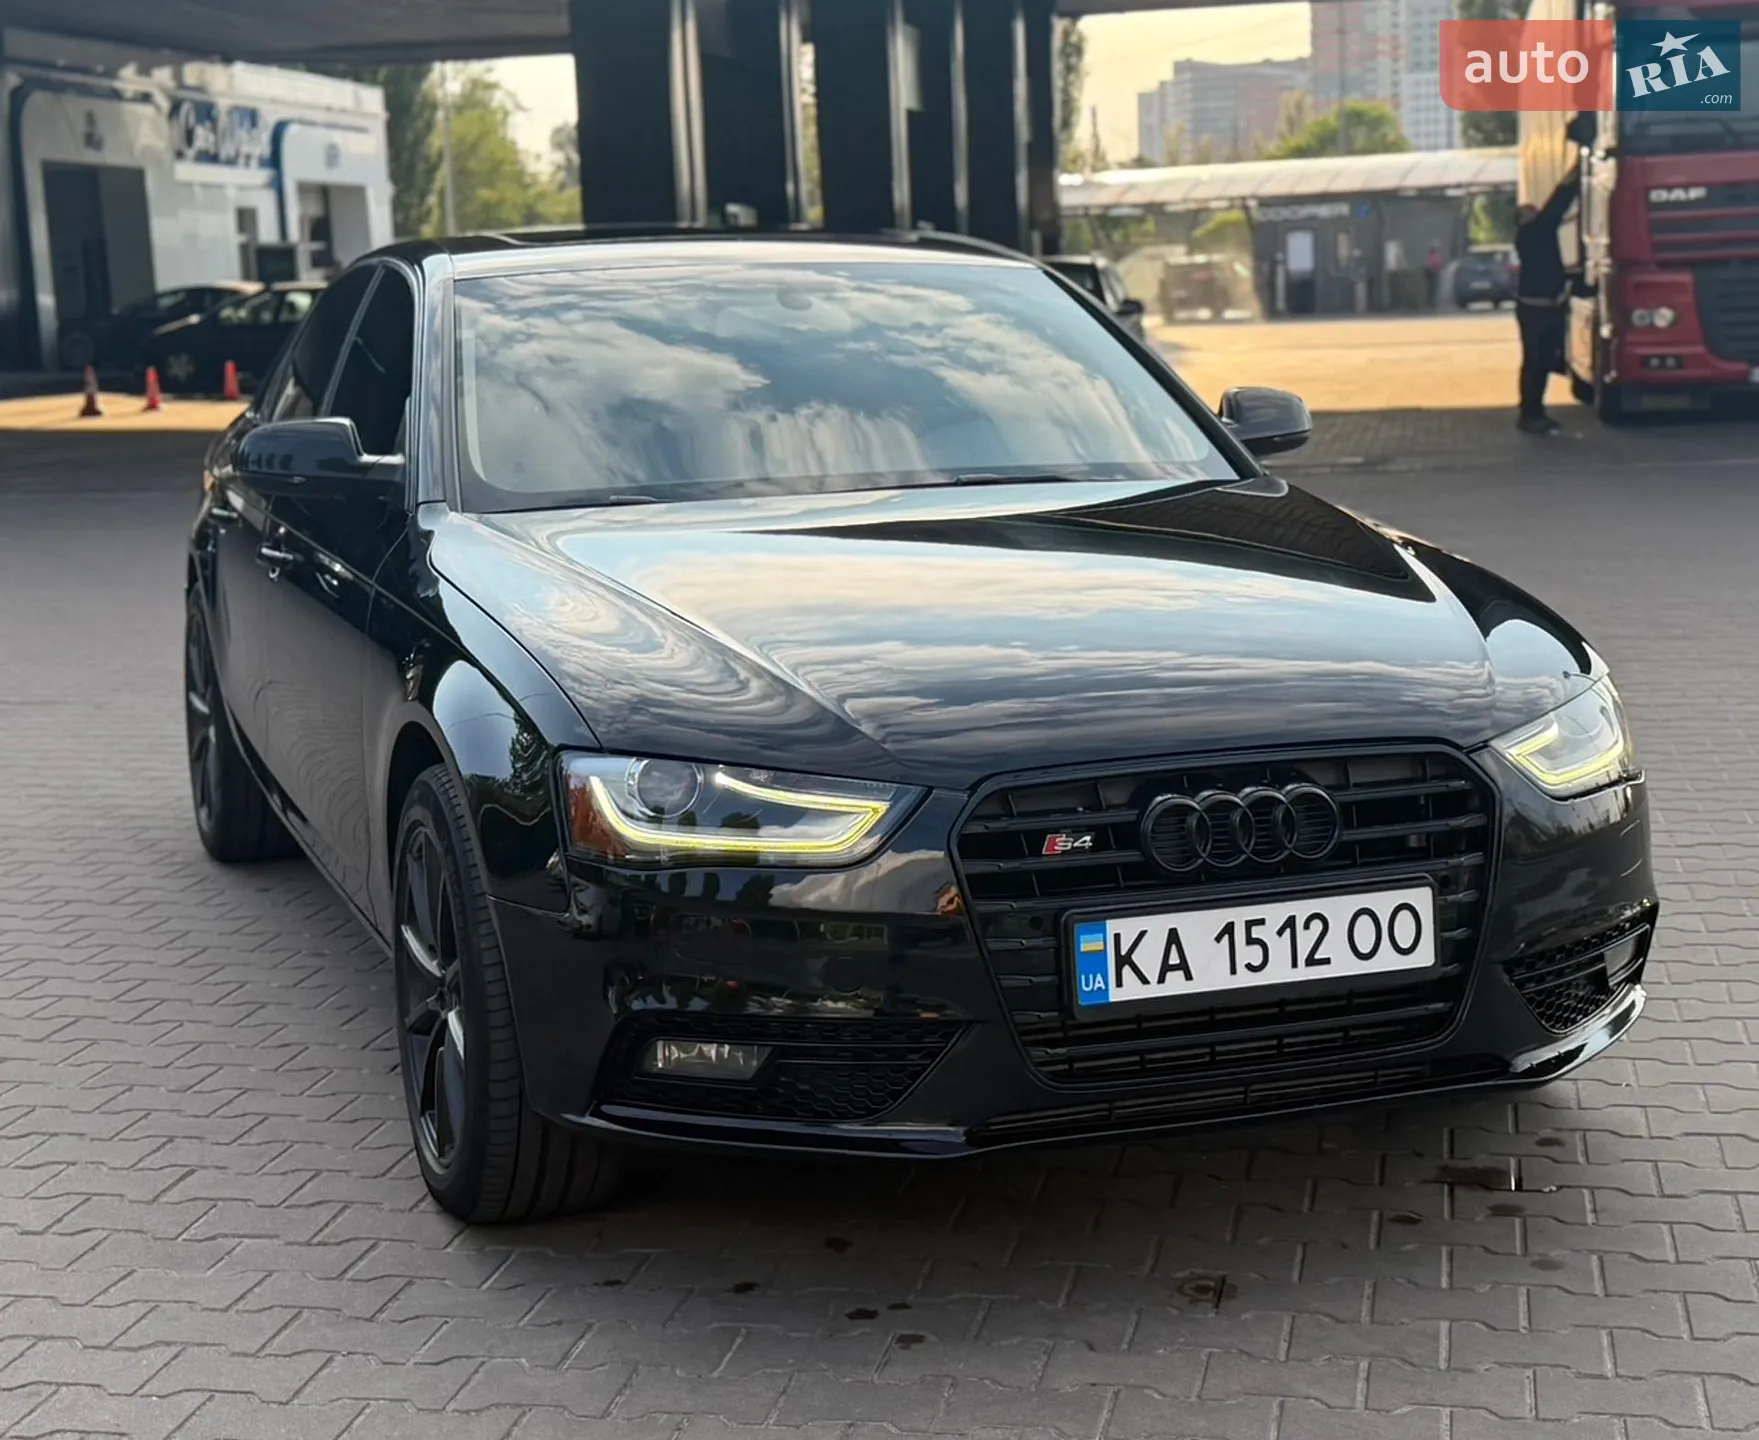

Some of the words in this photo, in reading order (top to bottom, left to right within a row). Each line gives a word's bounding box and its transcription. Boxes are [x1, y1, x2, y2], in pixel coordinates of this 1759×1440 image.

[1648, 187, 1708, 203] DAF
[1112, 927, 1194, 989] KA
[1213, 911, 1332, 977] 1512
[1346, 902, 1423, 961] OO
[1081, 973, 1106, 991] UA
